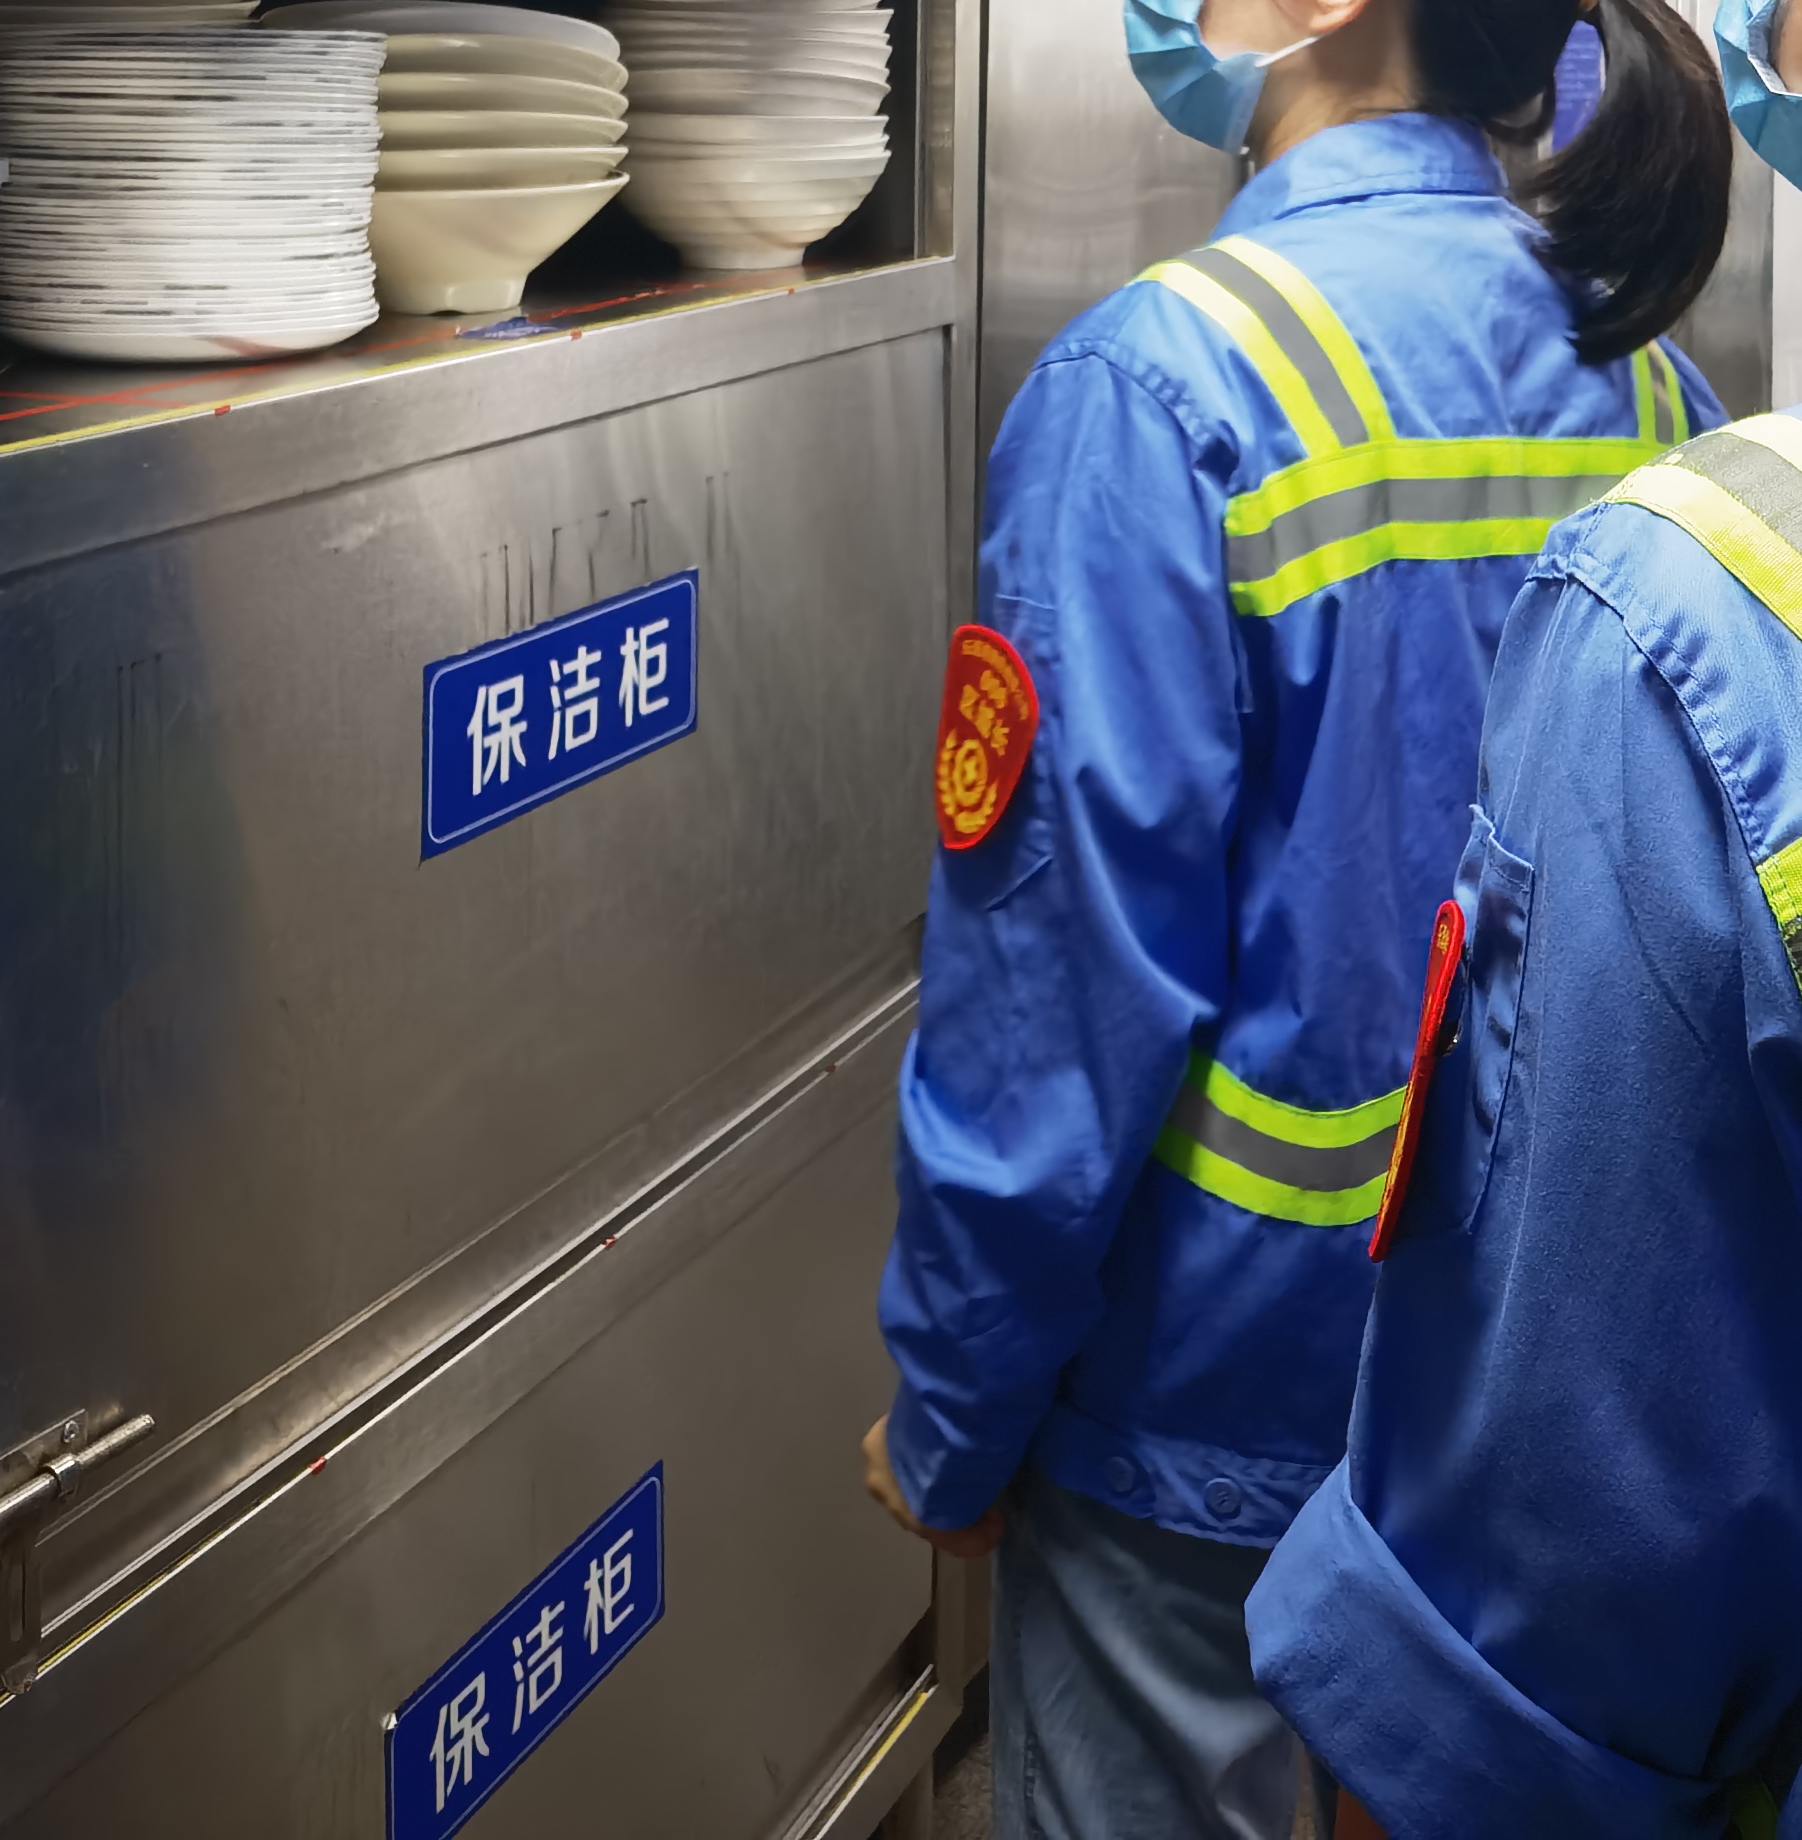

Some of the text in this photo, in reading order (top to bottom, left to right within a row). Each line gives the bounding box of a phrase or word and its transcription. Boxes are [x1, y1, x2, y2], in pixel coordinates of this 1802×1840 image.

[466, 617, 670, 797] 保洁柜
[429, 1527, 636, 1815] 保洁柜
